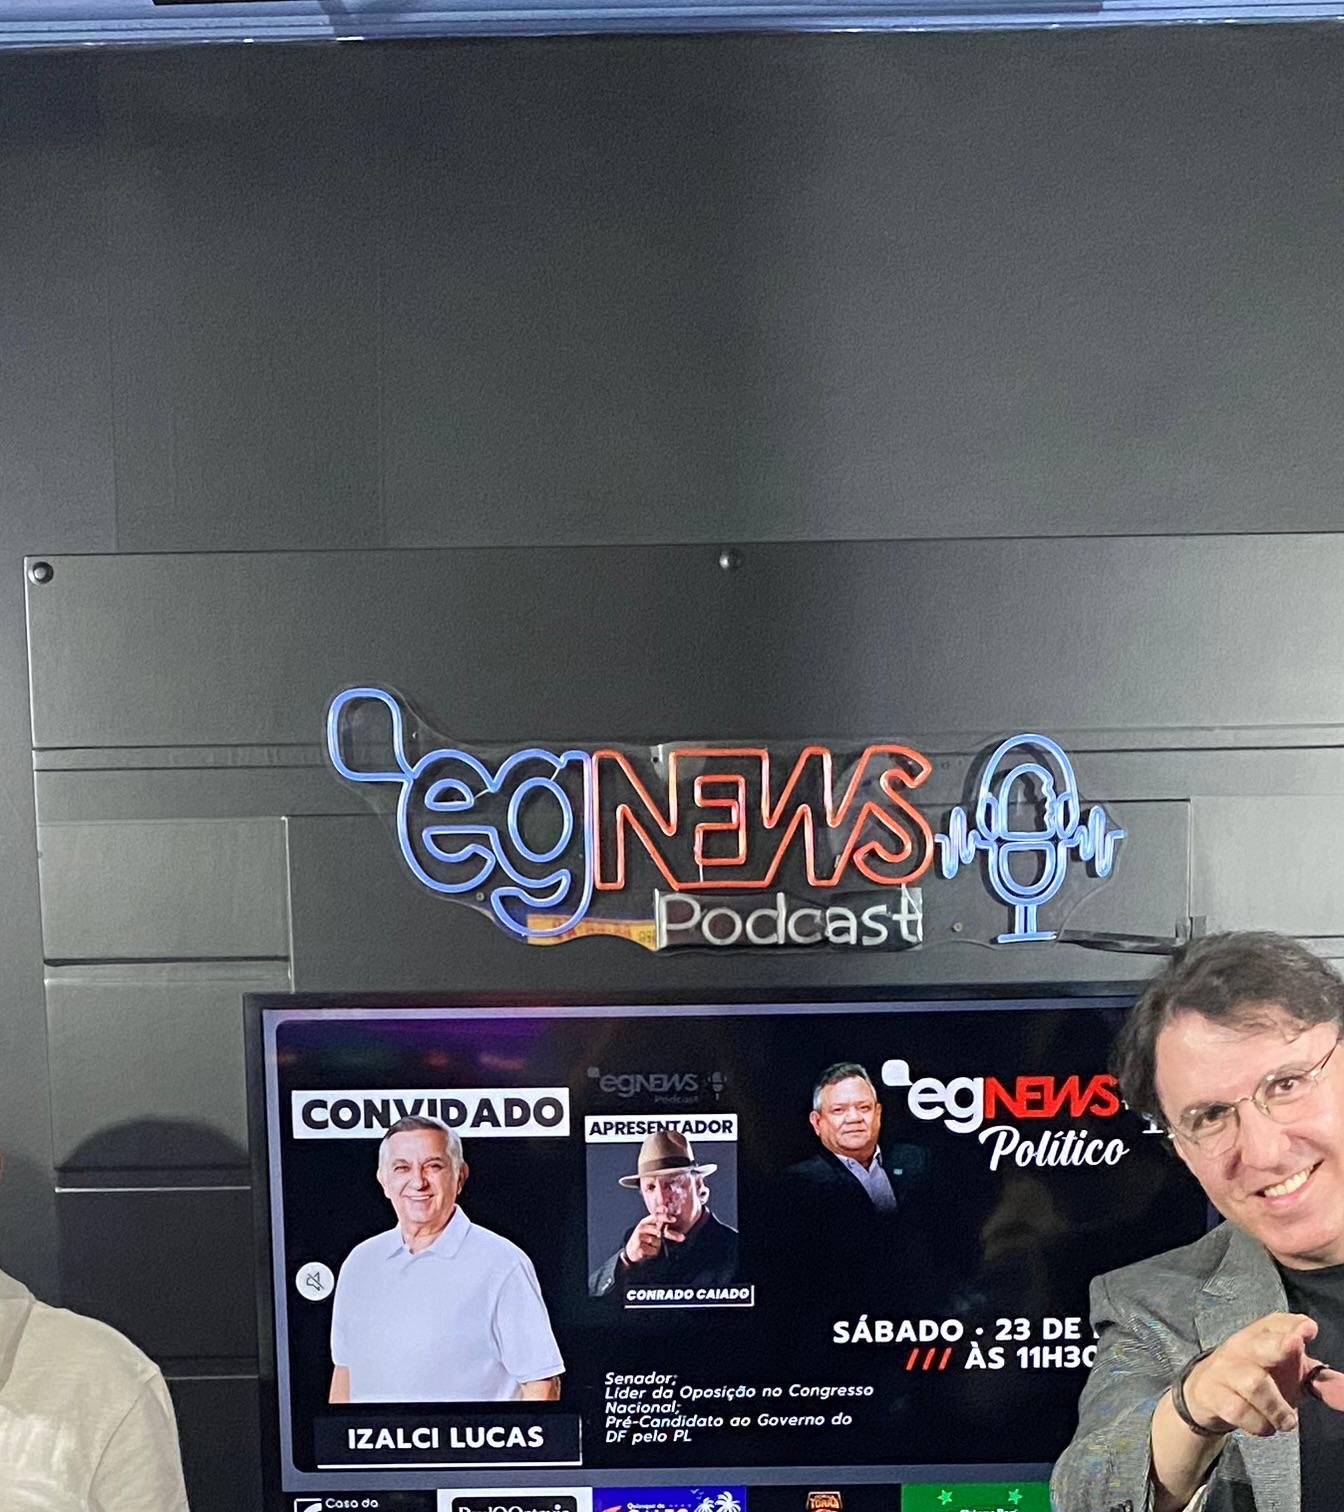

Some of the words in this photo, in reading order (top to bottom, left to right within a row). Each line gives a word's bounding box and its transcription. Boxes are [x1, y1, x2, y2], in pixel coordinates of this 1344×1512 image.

[656, 889, 922, 948] Podcast
[302, 1096, 564, 1130] CONVIDADO
[589, 1120, 733, 1136] APRESENTADOR
[978, 1125, 1130, 1171] Político
[626, 1289, 694, 1301] CONRADO
[696, 1288, 750, 1300] CAIADO
[832, 1314, 964, 1344] SÁBADO
[995, 1318, 1031, 1341] 23
[1042, 1317, 1081, 1340] DE
[964, 1341, 1005, 1369] ÀS
[604, 1386, 647, 1400] Líder
[652, 1386, 674, 1399] da
[679, 1385, 756, 1401] Oposição
[762, 1387, 783, 1397] no
[788, 1383, 874, 1400] Congresso
[605, 1414, 724, 1428] Pré-Candidato
[730, 1416, 751, 1427] ao
[757, 1413, 825, 1427] Governo
[831, 1412, 853, 1425] do
[348, 1428, 439, 1450] IZALCI
[449, 1426, 544, 1449] LUCAS
[605, 1430, 627, 1443] DF
[631, 1429, 668, 1445] pelo
[673, 1429, 693, 1442] PL
[325, 1498, 359, 1509] Casa
[361, 1498, 378, 1508] da
